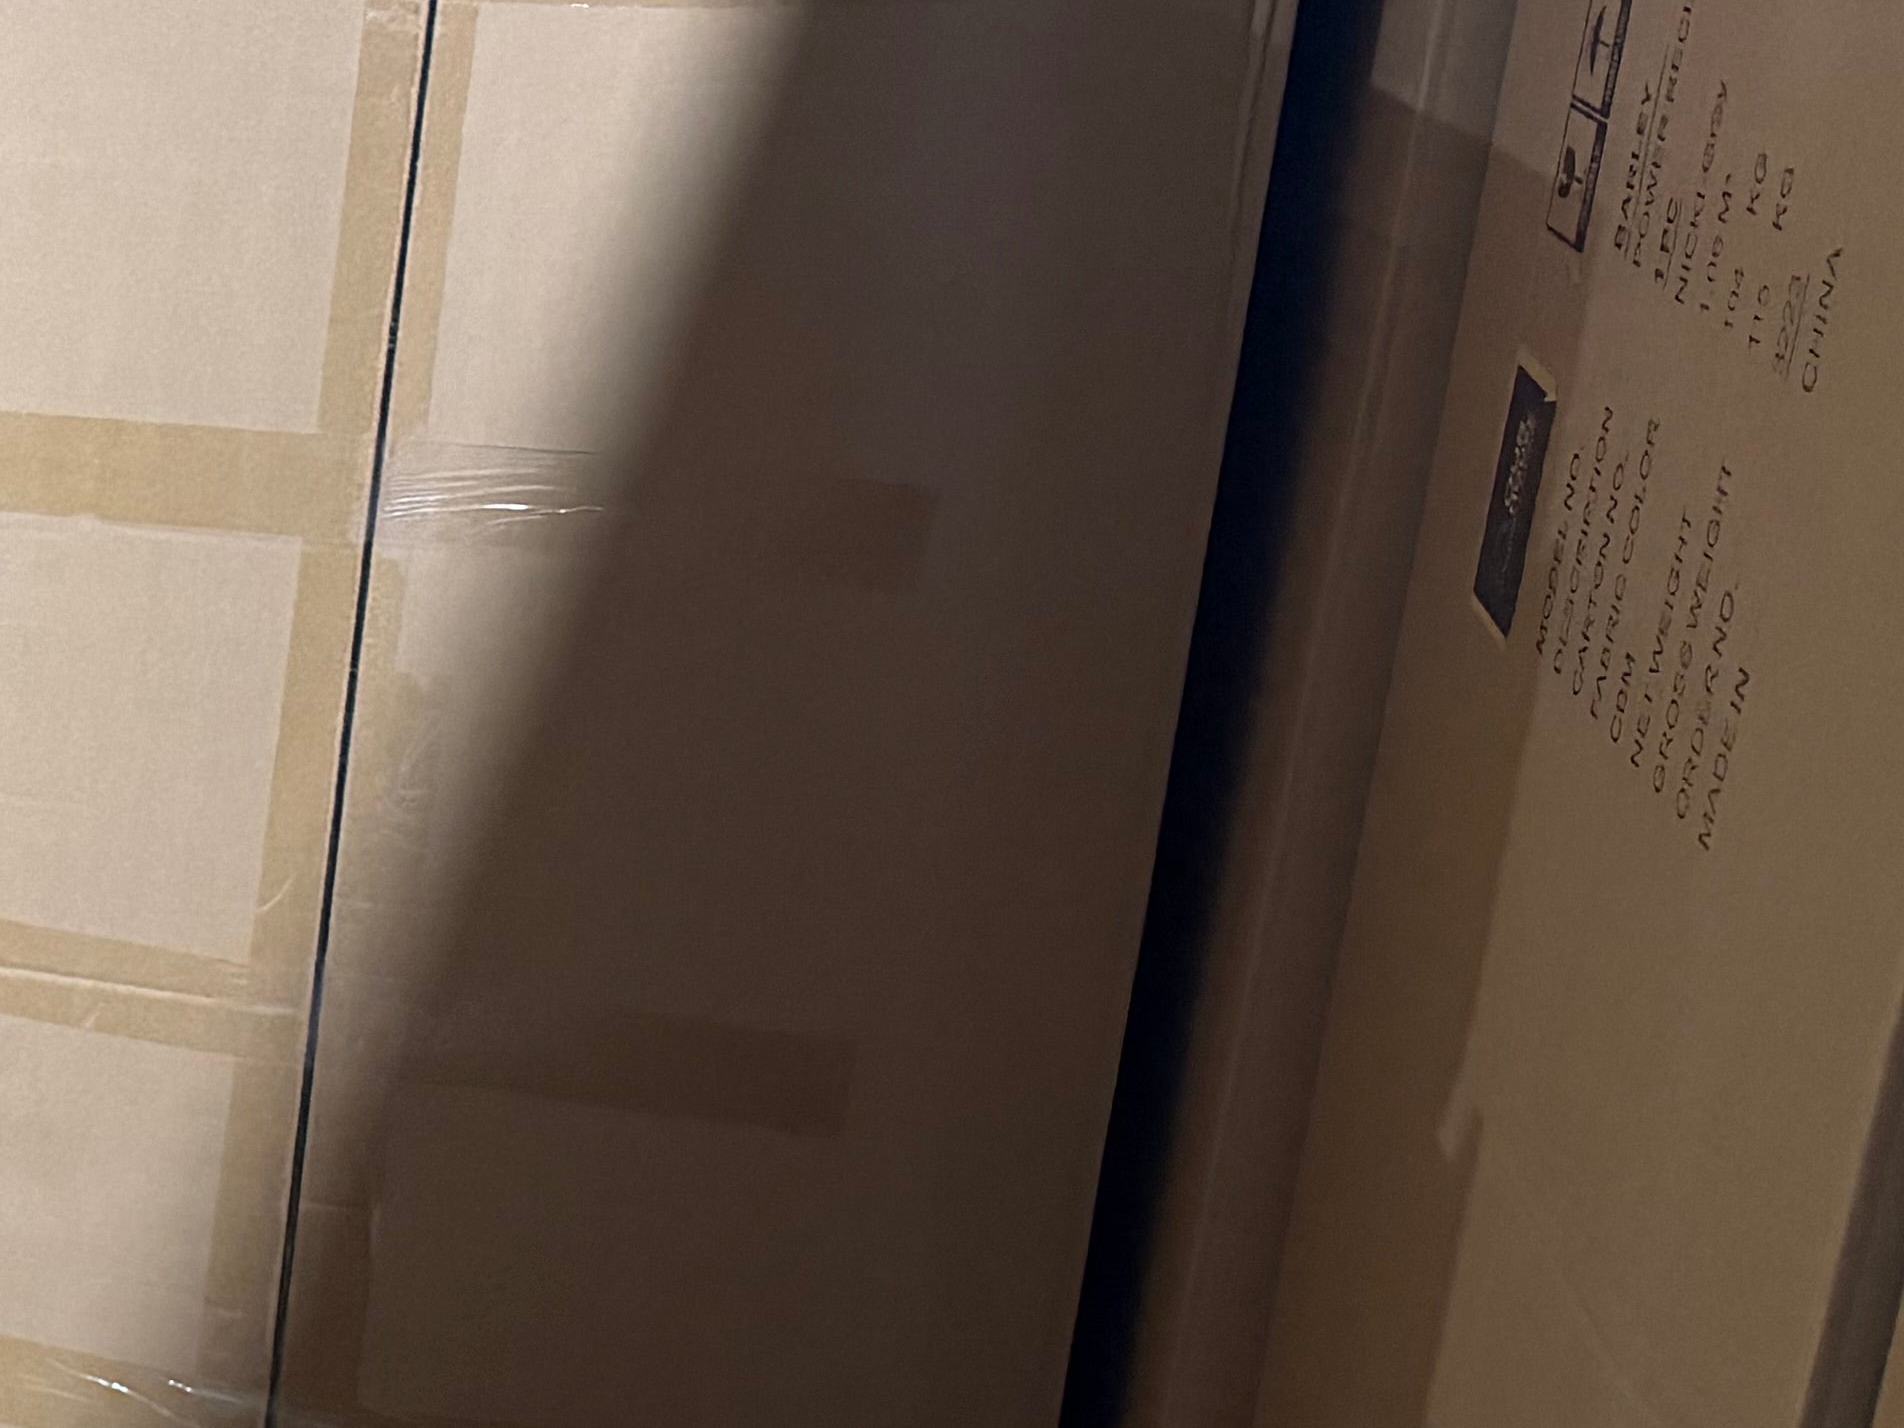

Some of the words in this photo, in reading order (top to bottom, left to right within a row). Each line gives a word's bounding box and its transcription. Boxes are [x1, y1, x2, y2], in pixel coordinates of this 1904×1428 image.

[1536, 521, 1569, 655] MODEL
[1614, 79, 1652, 251] BARLEY
[1553, 406, 1614, 675] DESCRIPTION
[1632, 114, 1669, 268] POWER
[1572, 532, 1611, 696] CARTON
[1590, 573, 1628, 720] FABRIC
[1622, 417, 1661, 565] COLOR
[1630, 683, 1653, 769] NET
[1648, 505, 1692, 674] WEIGHT
[1746, 152, 1769, 216] KG
[1652, 639, 1693, 794] GROSS
[1686, 455, 1733, 629] WEIGHT
[1771, 167, 1795, 232] KG
[1697, 717, 1738, 851] MADE
[1730, 666, 1751, 716] IN
[1801, 247, 1844, 393] CHINA
[1609, 651, 1636, 743] CBM
[1676, 663, 1720, 820] ORDER
